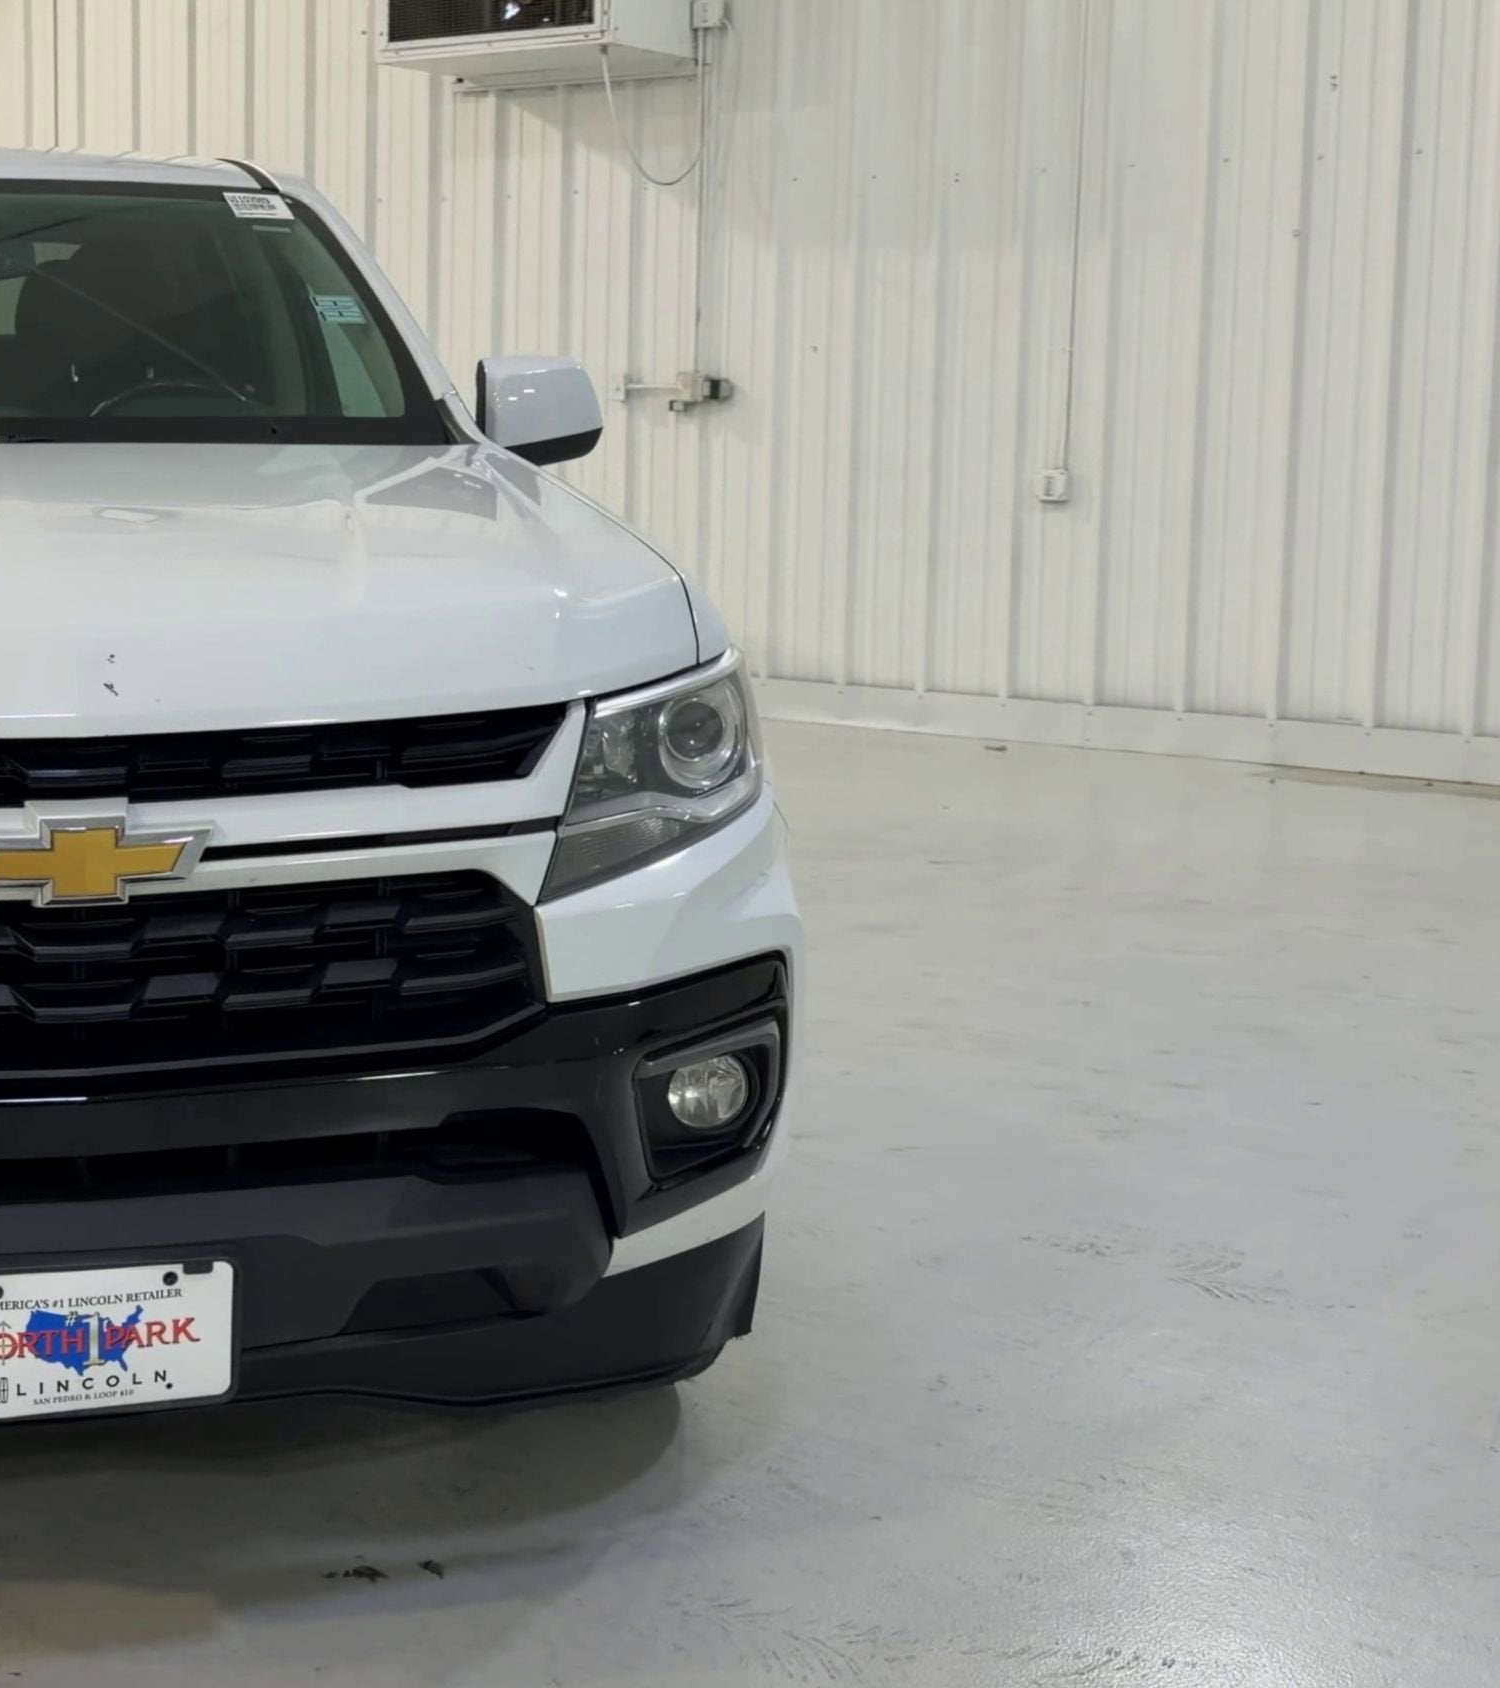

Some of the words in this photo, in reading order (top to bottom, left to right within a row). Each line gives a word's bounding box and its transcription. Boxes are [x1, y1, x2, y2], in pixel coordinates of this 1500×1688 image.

[68, 1294, 123, 1308] LINCOLN
[126, 1288, 182, 1303] RETAILER
[105, 1317, 201, 1351] PARK
[16, 1370, 167, 1397] LINCOLN
